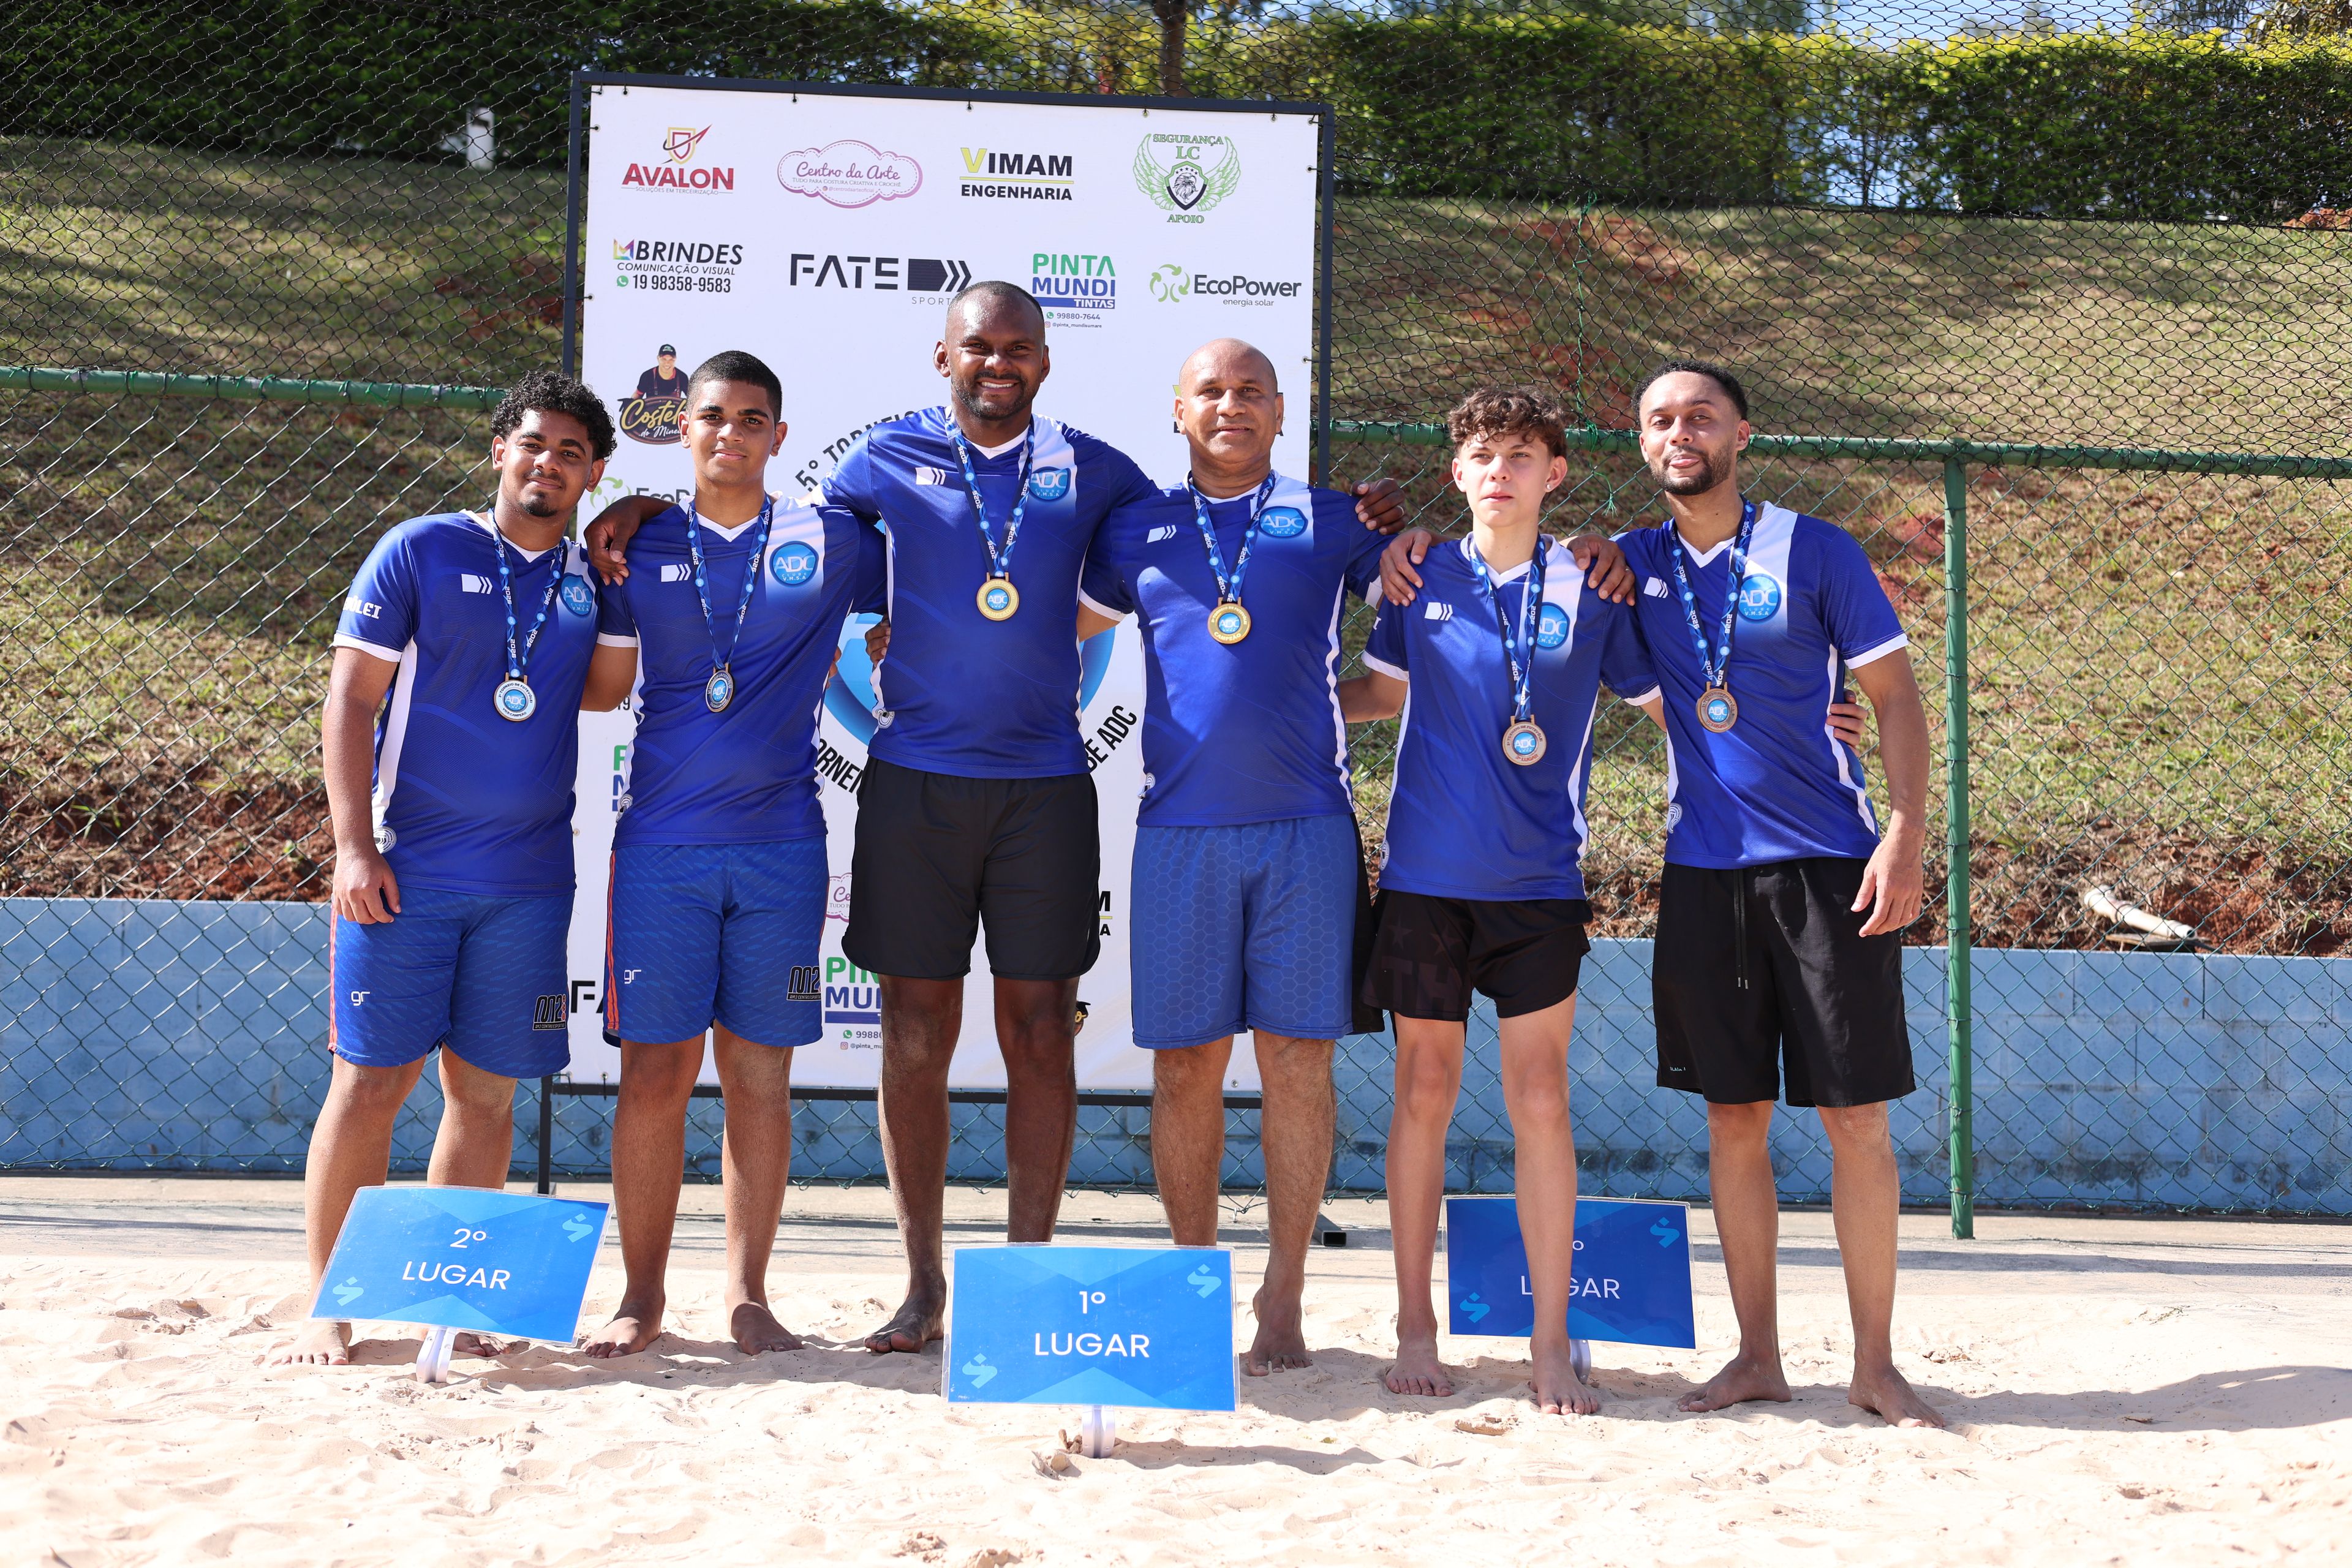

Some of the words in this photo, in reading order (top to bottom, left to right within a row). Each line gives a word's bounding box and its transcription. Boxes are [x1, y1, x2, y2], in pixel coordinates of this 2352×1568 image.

[1153, 134, 1224, 146] SEGURANÇA
[960, 147, 1072, 176] VIMAM
[1175, 146, 1200, 159] LC
[622, 163, 734, 190] AVALON
[796, 161, 843, 178] Centro
[846, 162, 864, 179] da
[867, 165, 901, 180] Arte
[961, 184, 1072, 200] ENGENHARIA
[1167, 214, 1205, 224] APOIO
[617, 262, 699, 274] COMUNICAÇÃO
[703, 266, 736, 276] VISUAL
[790, 254, 899, 290] FATE
[1033, 254, 1115, 276] PINTA
[633, 274, 647, 289] 19
[651, 275, 731, 293] 98358-9583
[1032, 277, 1115, 297] MUNDI
[1194, 274, 1302, 296] EcoPower
[1074, 299, 1114, 308] TINTAS
[1031, 472, 1068, 488] ADC
[1261, 514, 1303, 529] ADC
[774, 554, 815, 572] ADC
[987, 595, 1008, 604] ADC
[1740, 589, 1777, 607] ADC
[1219, 619, 1239, 628] ADC
[1214, 631, 1242, 641] CAMPEÃO
[505, 695, 525, 706] ADC
[1708, 706, 1727, 715] ADC
[1096, 705, 1137, 751] ADC
[1515, 739, 1536, 748] ADC
[450, 1227, 486, 1248] 2º
[402, 1261, 511, 1290] LUGAR
[1521, 1275, 1621, 1299] LGAR
[1079, 1291, 1106, 1314] 1º
[1035, 1333, 1150, 1358] LUGAR
